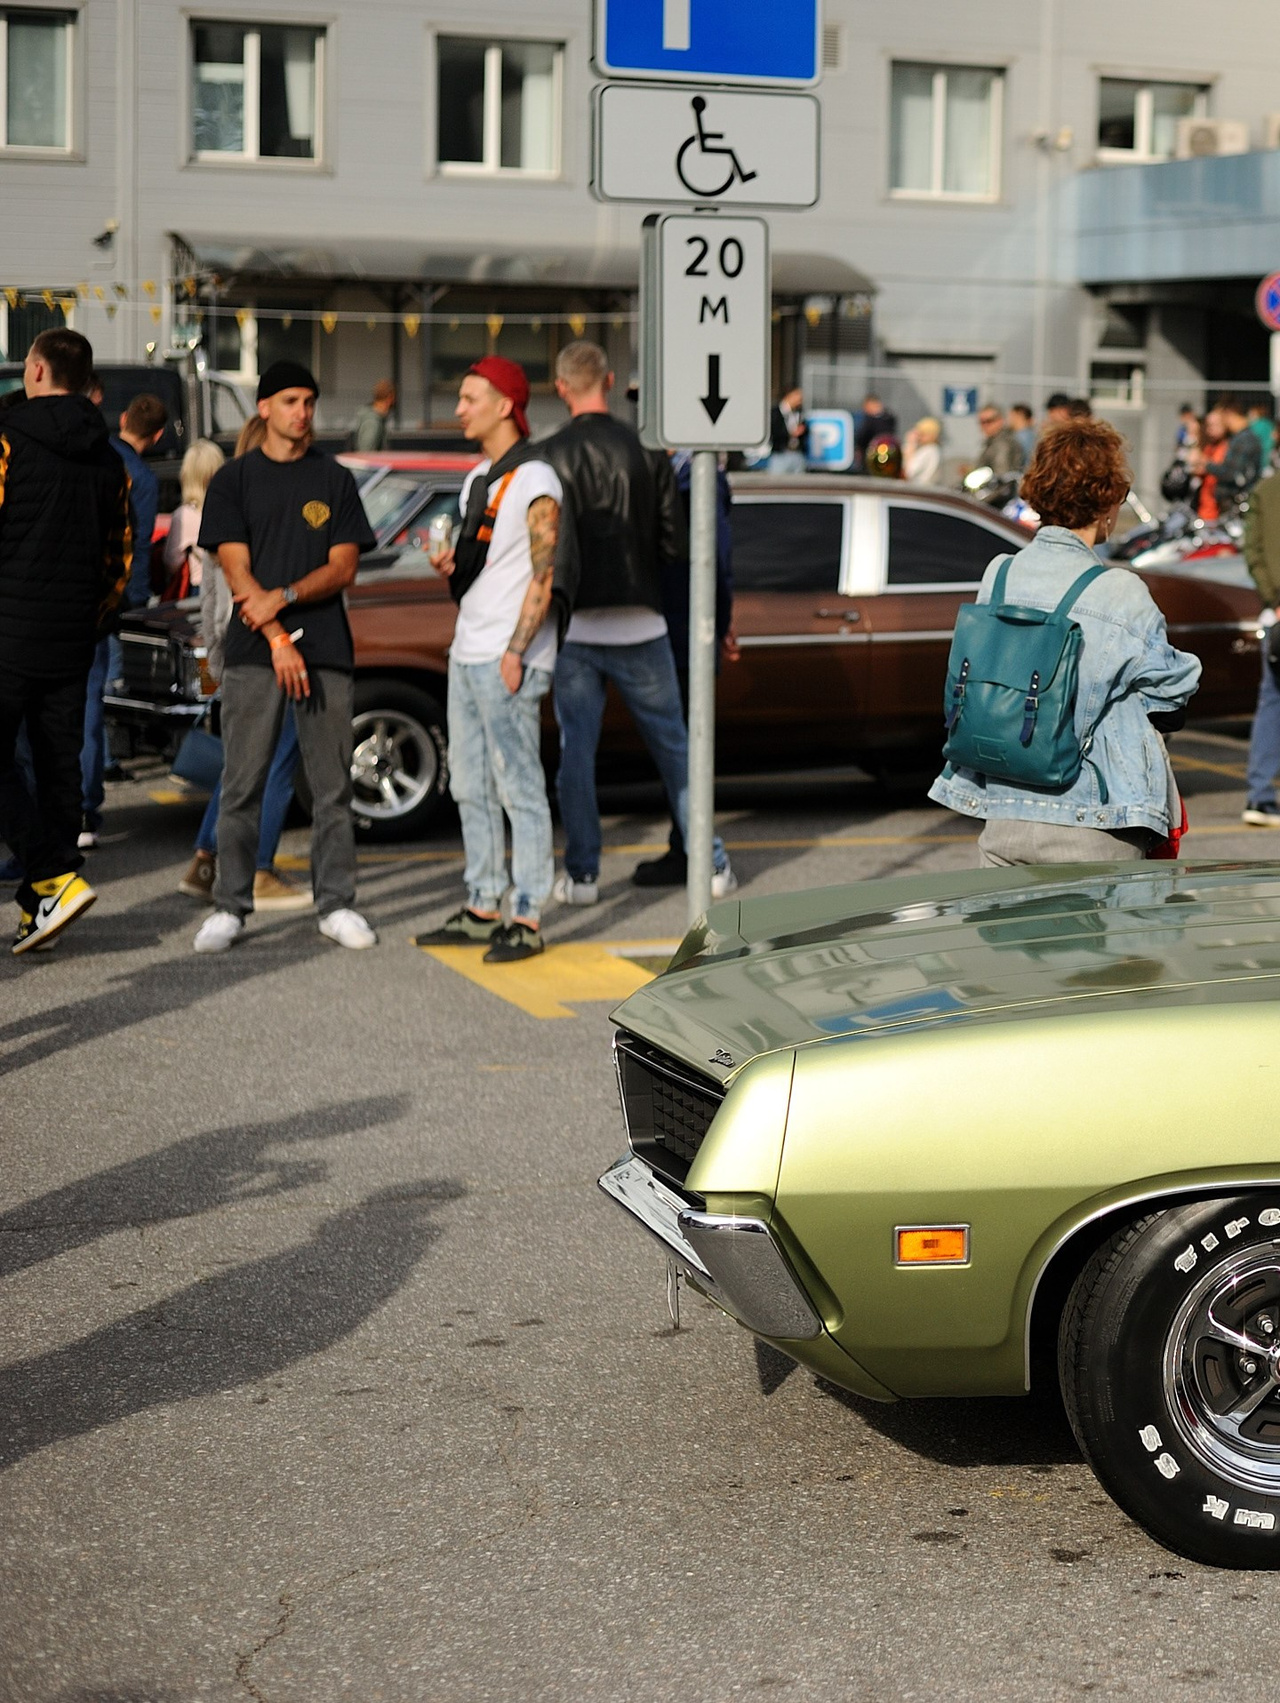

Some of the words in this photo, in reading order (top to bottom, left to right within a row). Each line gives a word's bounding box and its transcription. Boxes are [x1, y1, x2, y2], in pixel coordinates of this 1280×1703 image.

[684, 236, 744, 278] 20
[809, 421, 841, 461] P
[1138, 1424, 1181, 1479] SS
